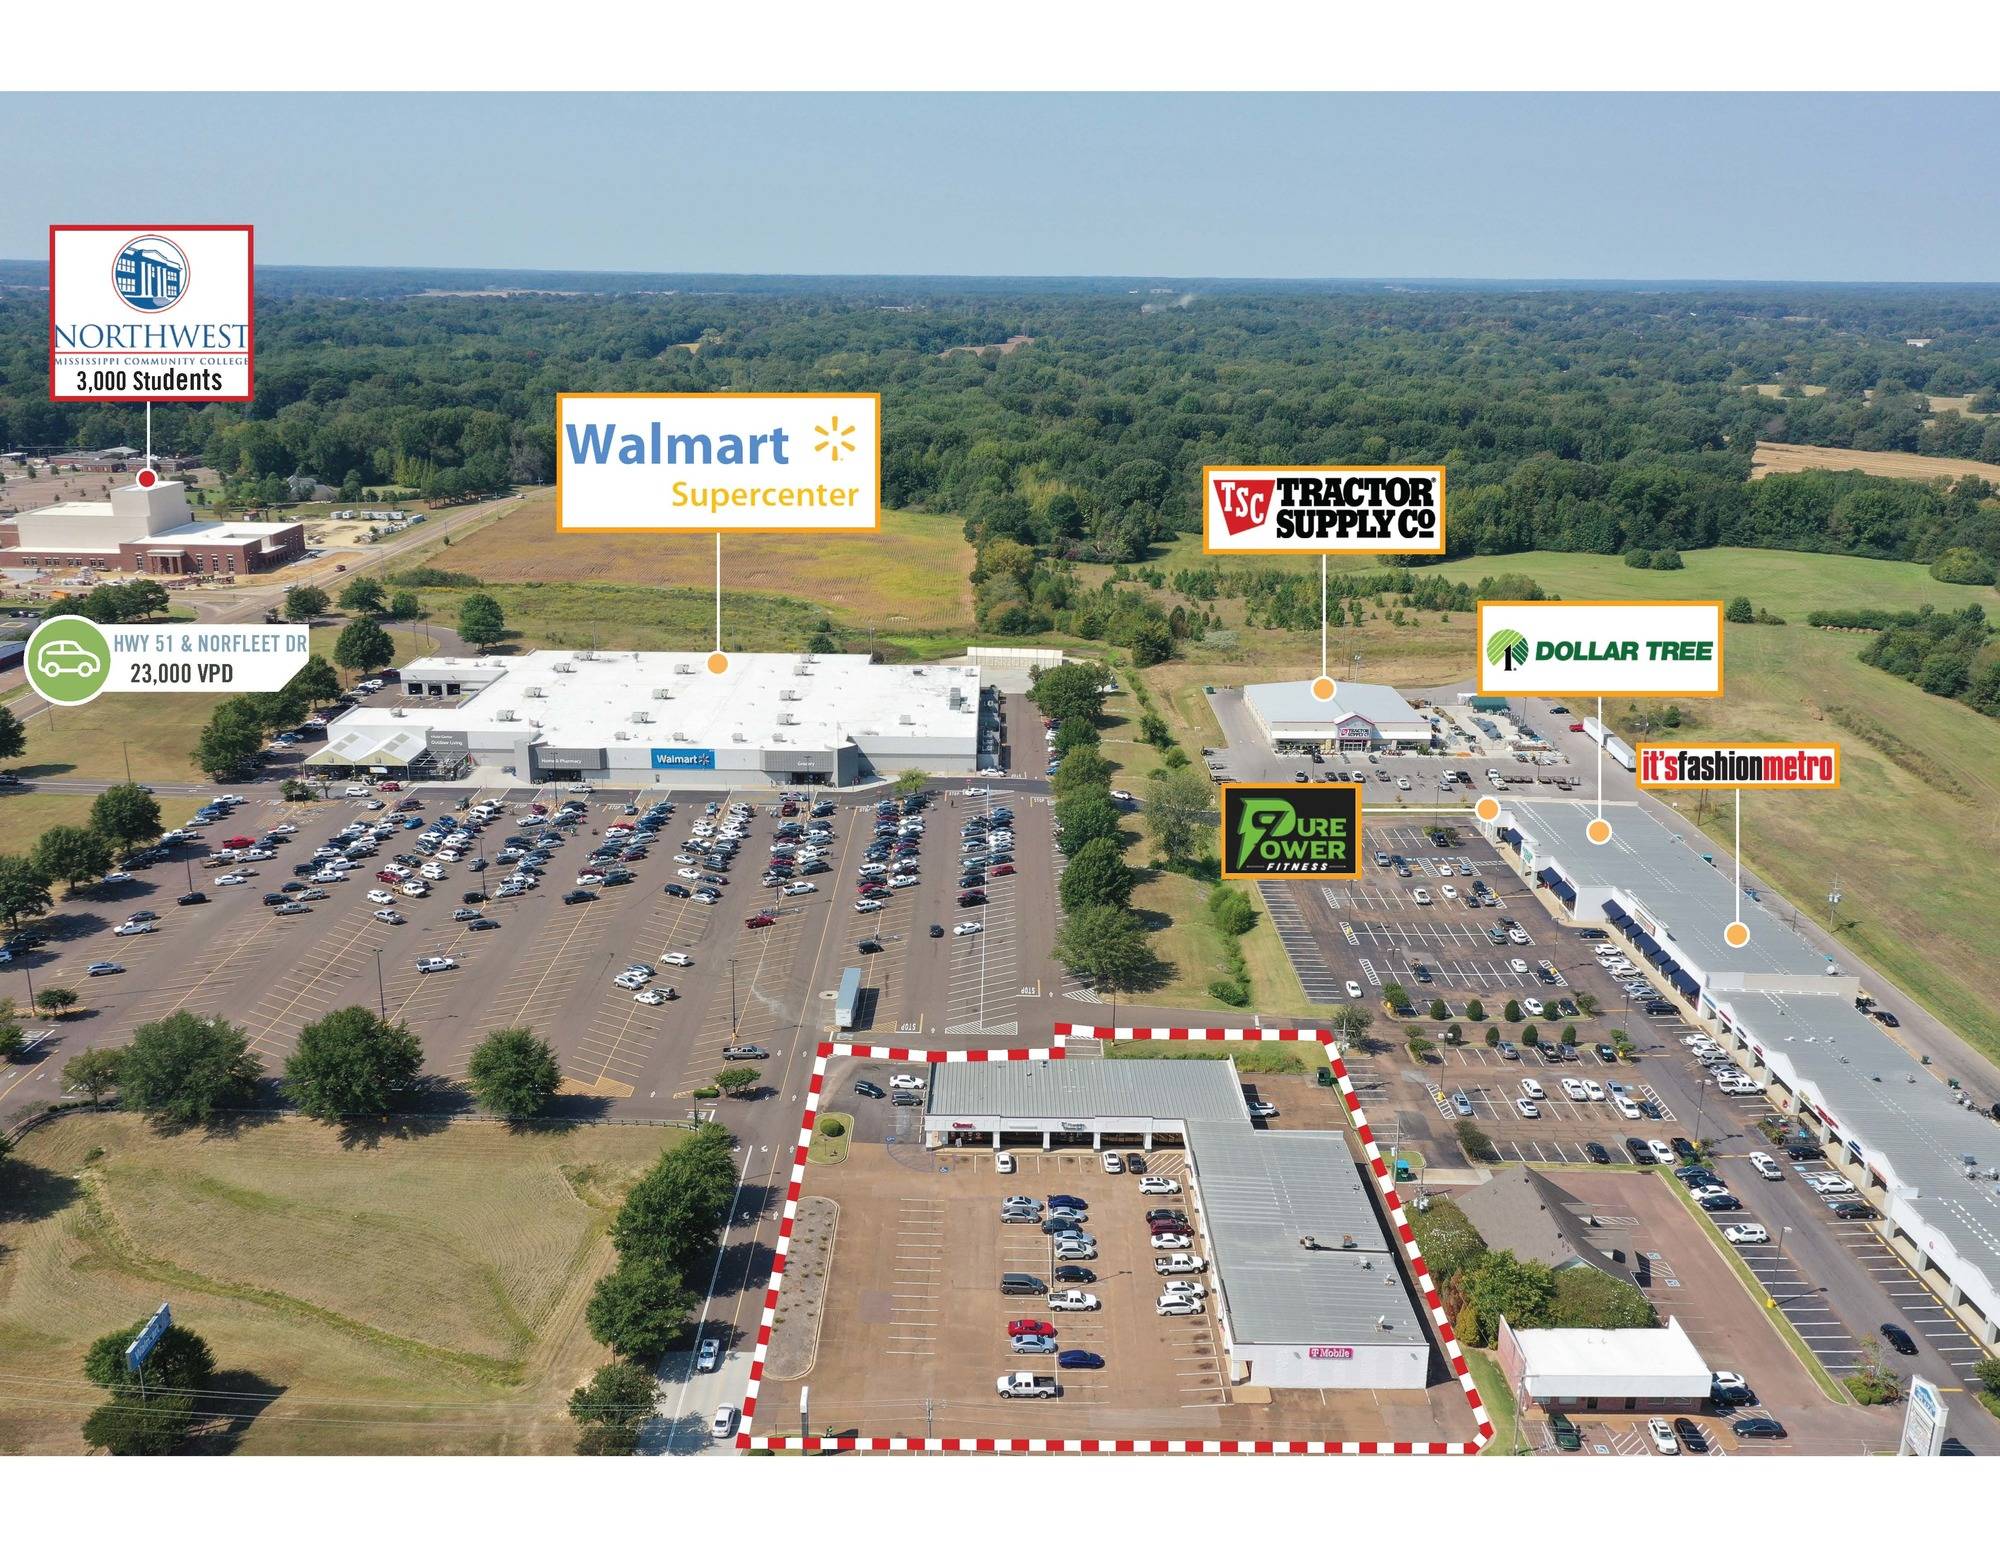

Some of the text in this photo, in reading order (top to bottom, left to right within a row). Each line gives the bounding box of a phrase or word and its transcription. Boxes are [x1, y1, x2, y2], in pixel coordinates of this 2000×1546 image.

[656, 754, 698, 764] Walmart
[1020, 986, 1036, 994] STOP
[900, 1023, 917, 1031] STOP
